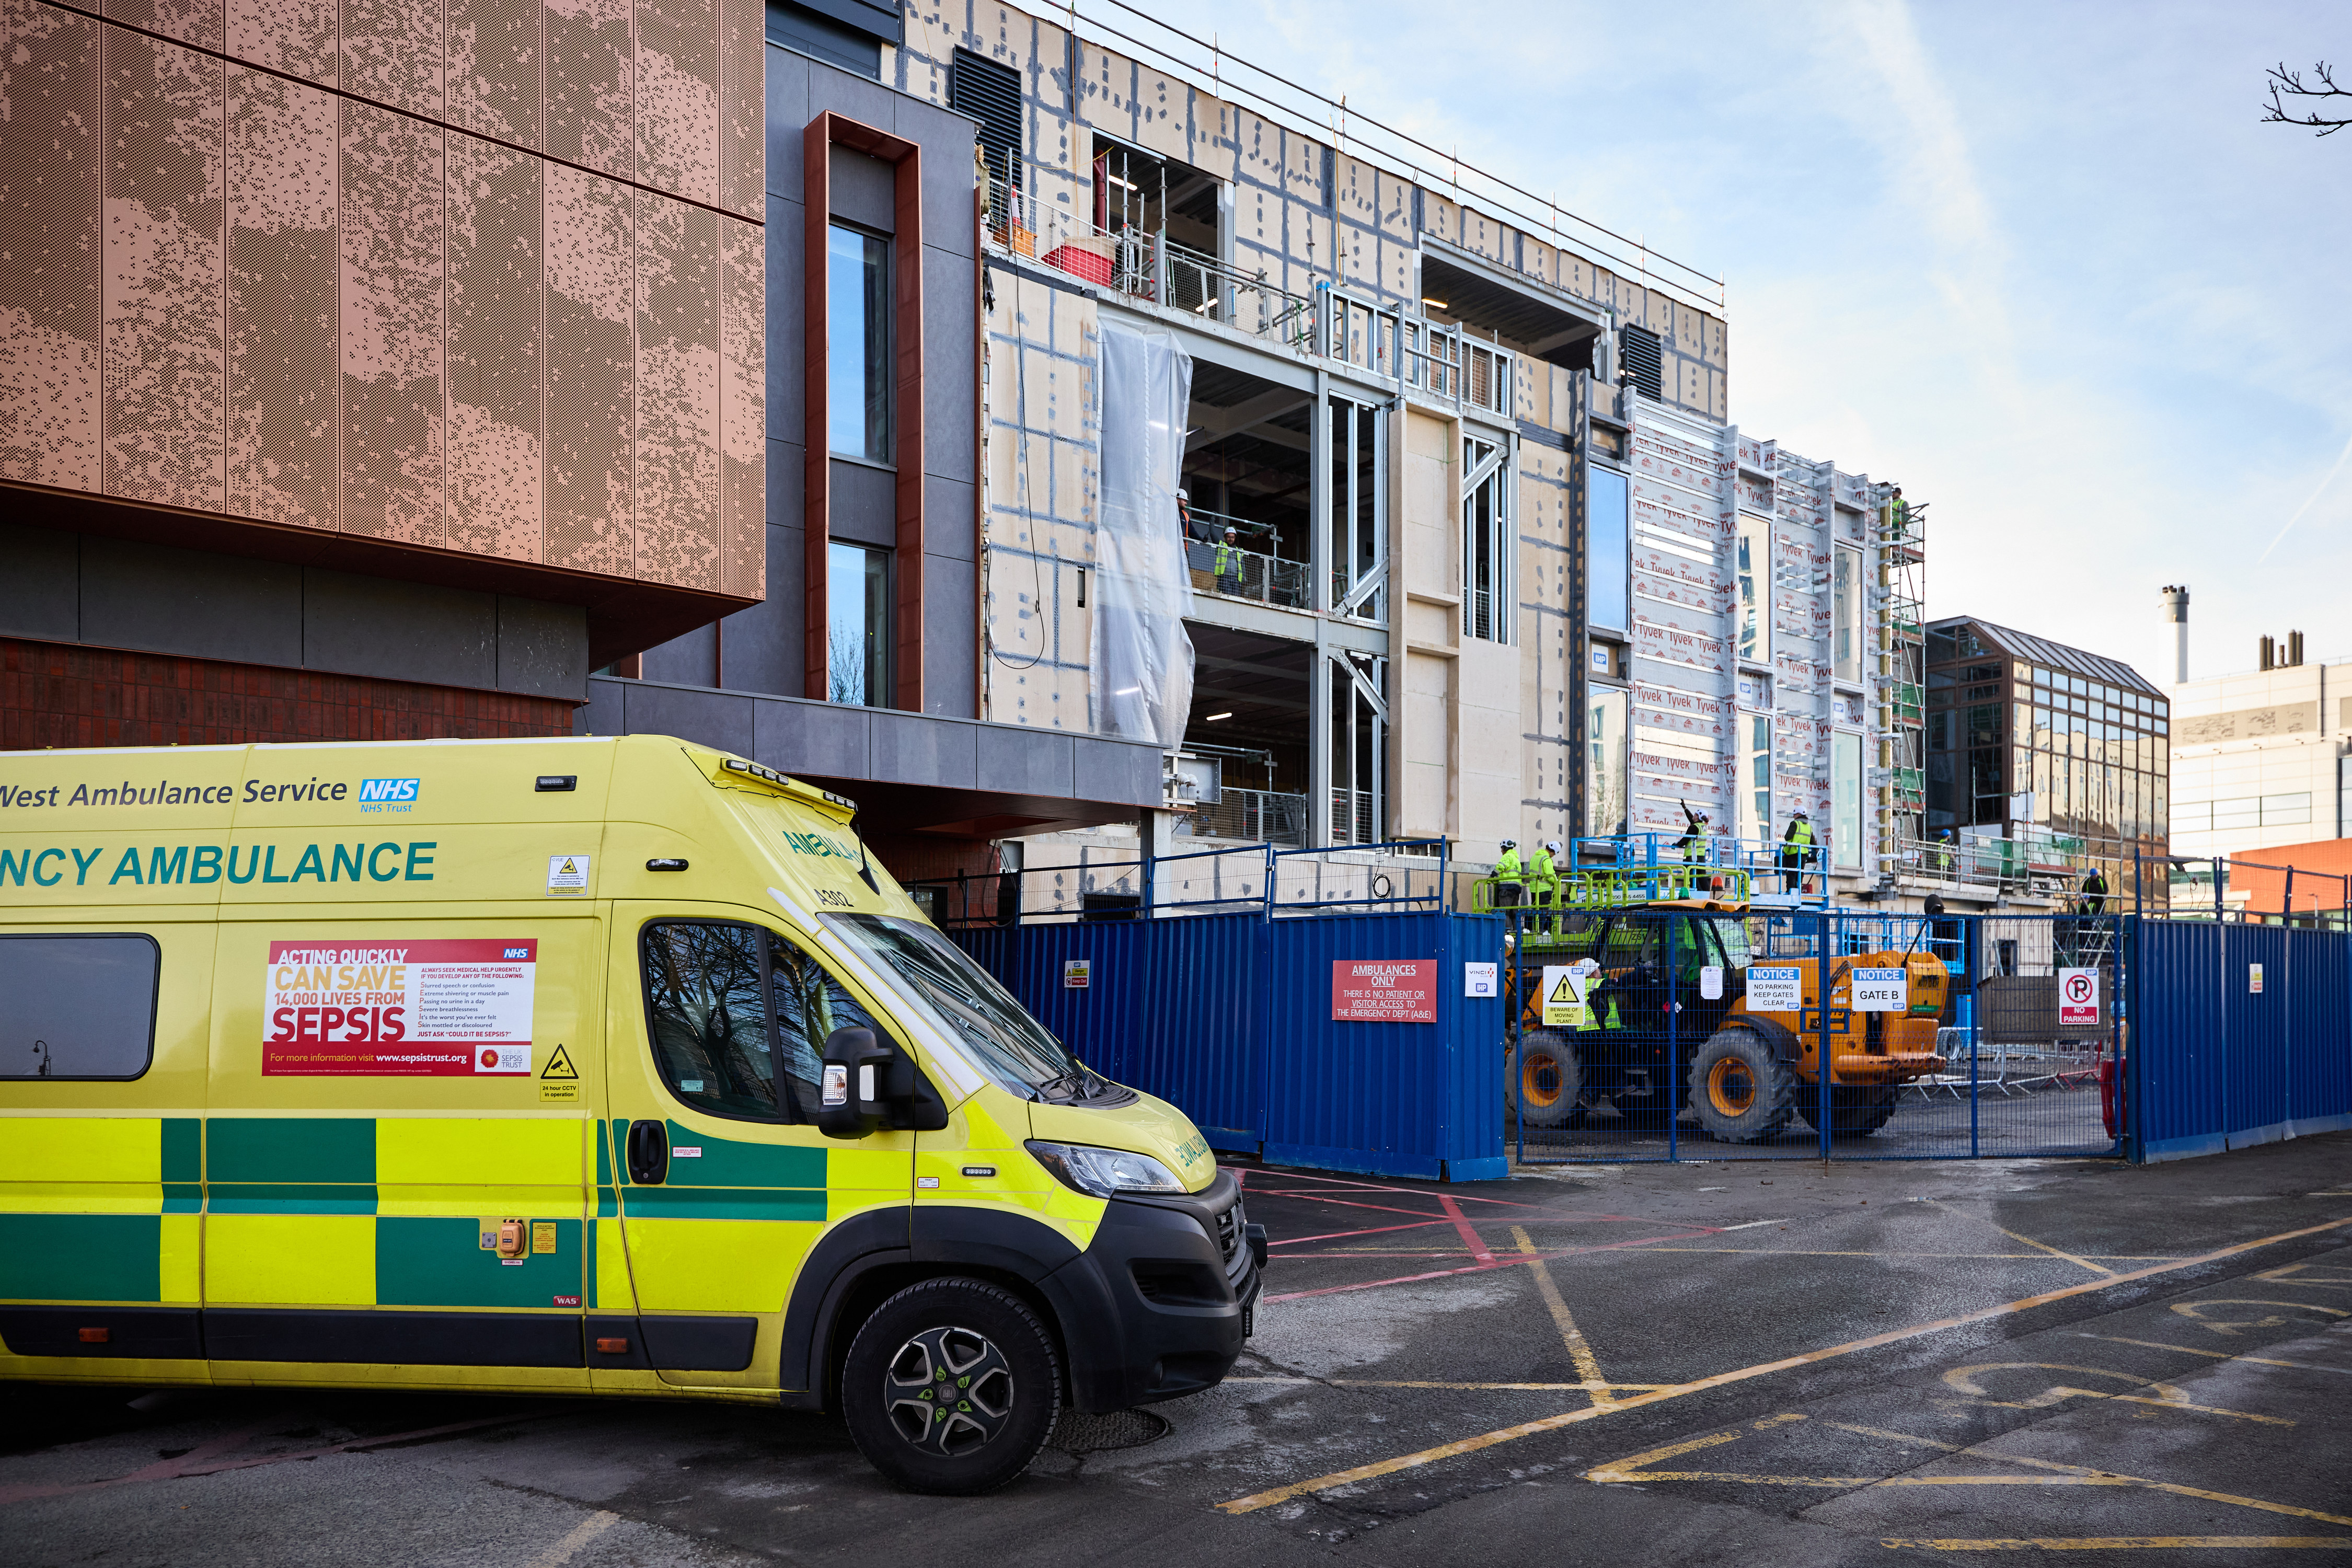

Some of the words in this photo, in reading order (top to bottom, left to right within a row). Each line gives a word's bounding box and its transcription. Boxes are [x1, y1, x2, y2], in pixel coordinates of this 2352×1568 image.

[1807, 550, 1831, 564] Tyvek
[1670, 631, 1692, 646] Tyvek
[1596, 654, 1606, 663] IHP
[1788, 660, 1808, 674] Tyvek
[1636, 687, 1661, 702] Tyvek
[1667, 693, 1691, 708] Tyvek
[1697, 698, 1720, 713] Tyvek
[1791, 718, 1811, 732] Tyvek
[1636, 753, 1660, 767] Tyvek
[1667, 758, 1689, 770] Tyvek
[1697, 763, 1719, 775] Tyvek
[1781, 776, 1800, 788] Tyvek
[1806, 779, 1829, 791] Tyvek
[67, 780, 233, 806] Ambulance
[243, 777, 347, 803] Service
[360, 779, 417, 800] NHS
[361, 804, 382, 813] NHS
[387, 804, 412, 813] Trust
[108, 842, 437, 885] AMBULANCE
[814, 889, 855, 907] A302
[277, 950, 337, 964] ACTING
[340, 949, 408, 964] QUICKLY
[504, 949, 527, 958] NHS
[1352, 965, 1416, 975] AMBULANCES
[1754, 970, 1794, 979] NOTICE
[1859, 971, 1899, 979] NOTICE
[275, 966, 332, 990] CAN
[337, 965, 406, 990] SAVE
[1371, 976, 1396, 986] ONLY
[274, 993, 318, 1007] 14,000
[322, 993, 362, 1005] LIVES
[365, 992, 405, 1005] FROM
[1860, 991, 1888, 999] GATE
[1892, 991, 1898, 999] B
[1412, 1010, 1431, 1019] (A&E)
[271, 1007, 406, 1042] SEPSIS
[376, 1053, 467, 1064] www.sepsistrust.org
[942, 1389, 953, 1398] FIAT
